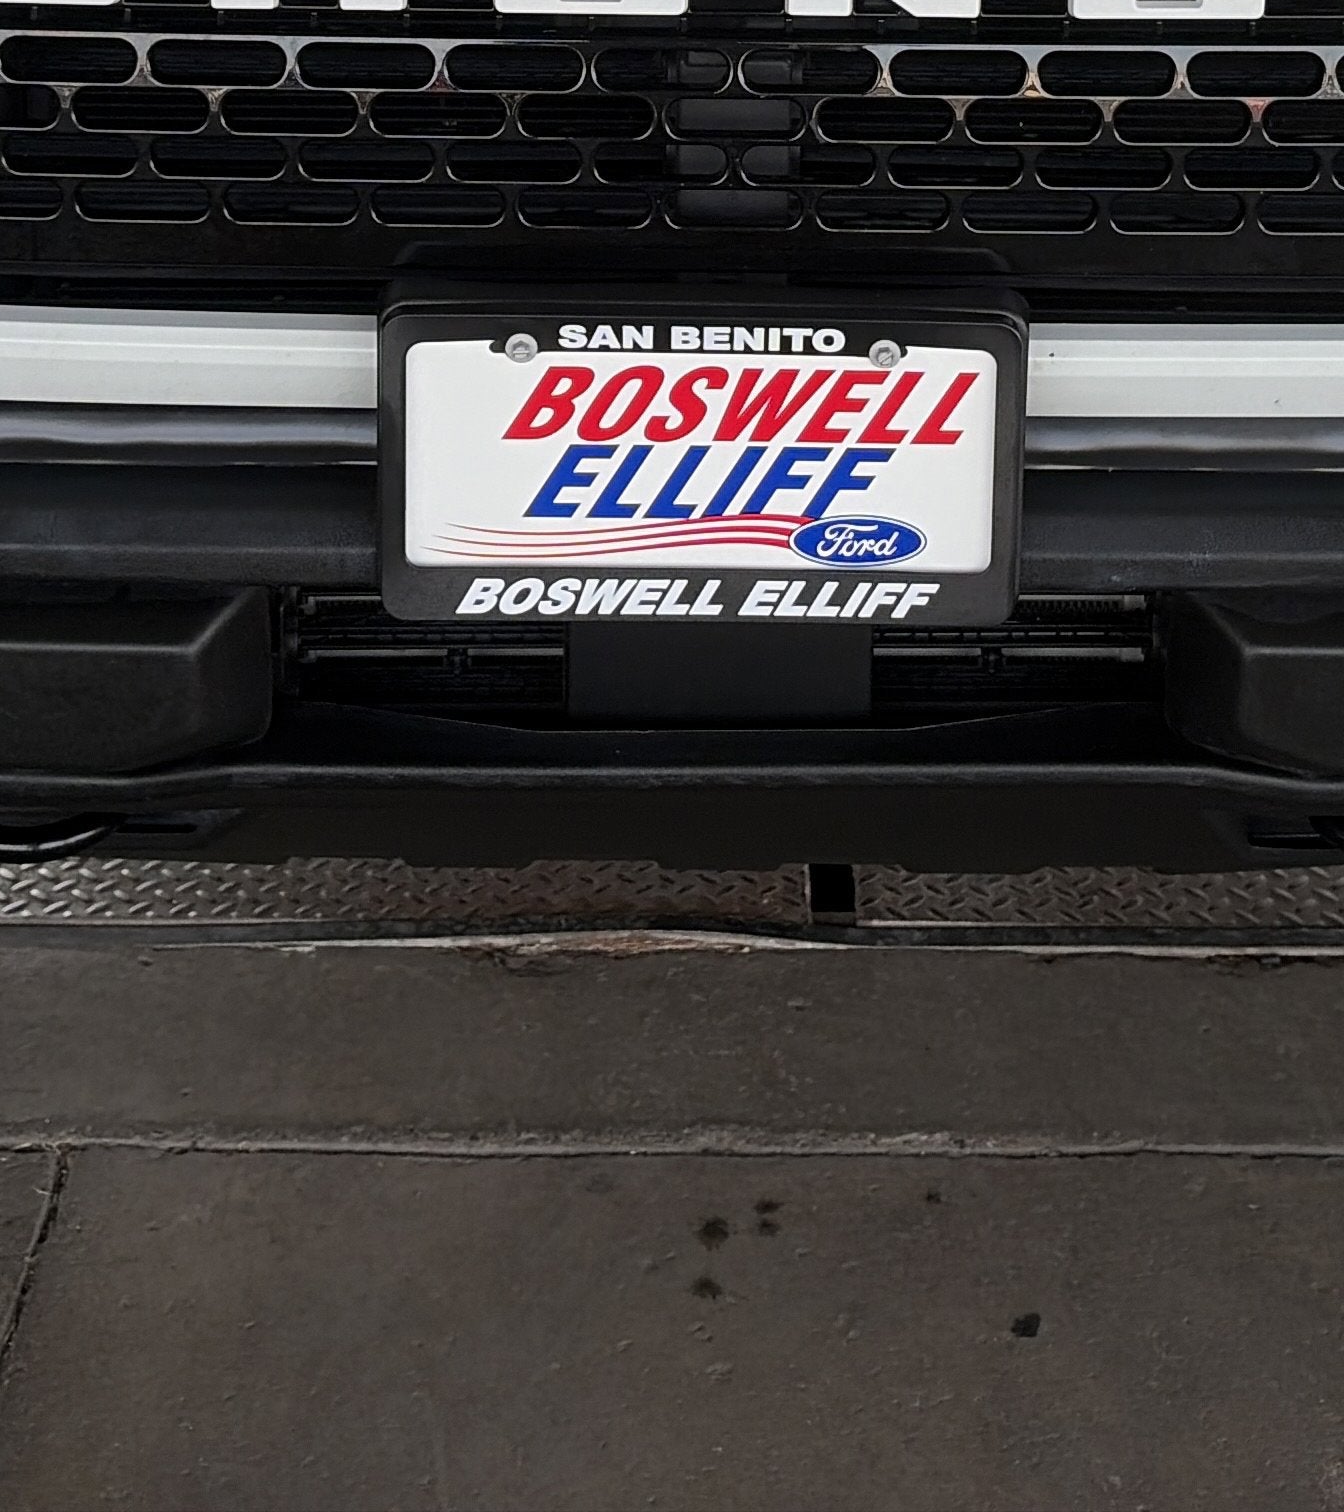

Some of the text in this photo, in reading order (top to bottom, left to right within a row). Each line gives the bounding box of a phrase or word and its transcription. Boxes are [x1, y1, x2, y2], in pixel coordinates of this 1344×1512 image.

[558, 324, 846, 353] SAN BENITO
[502, 365, 979, 444] BOSWELL
[522, 444, 897, 519] ELLIFF
[816, 524, 899, 557] Ford
[455, 578, 940, 619] BOSWELL ELLIFF
